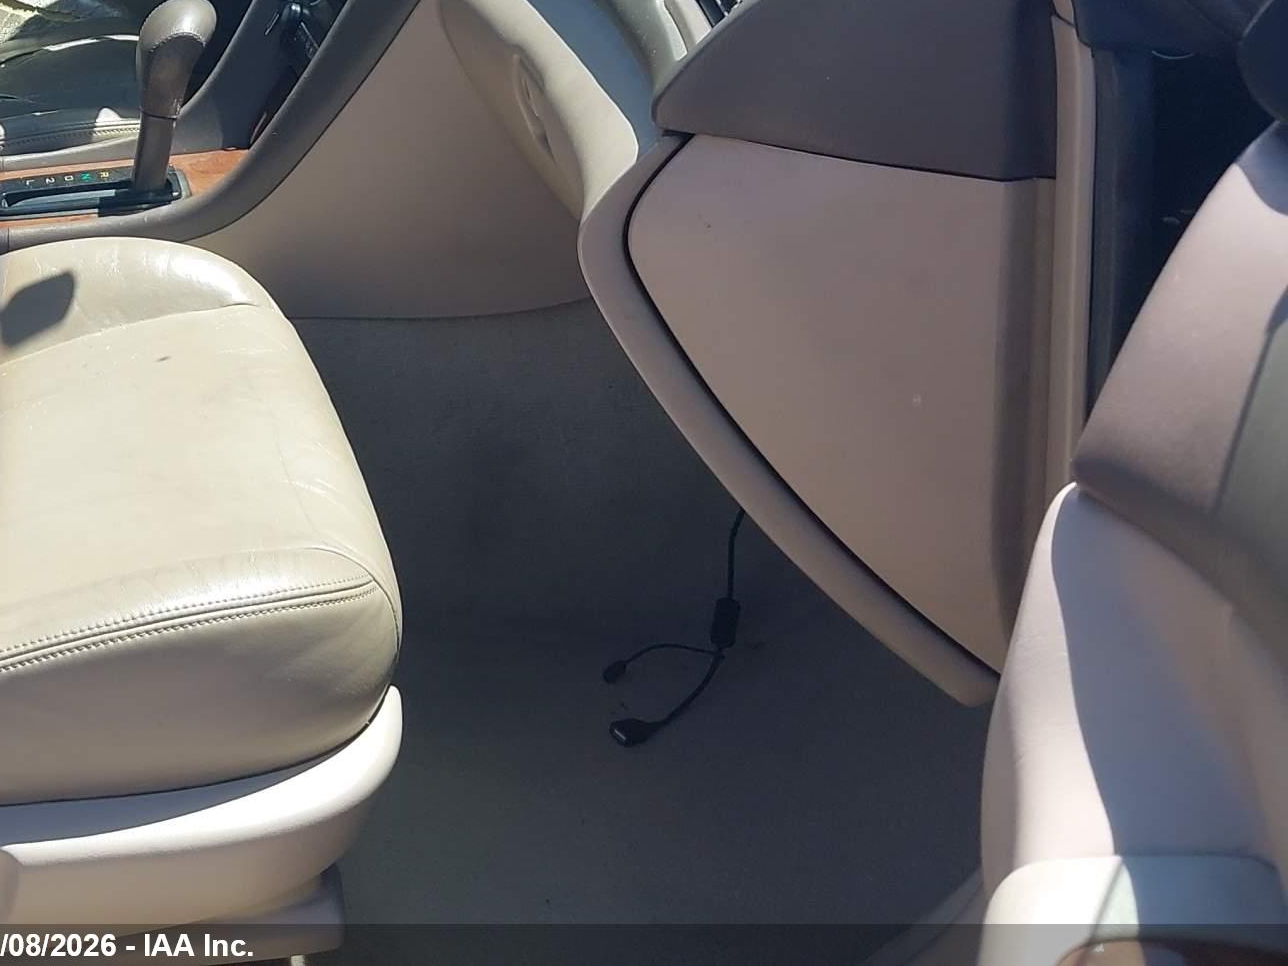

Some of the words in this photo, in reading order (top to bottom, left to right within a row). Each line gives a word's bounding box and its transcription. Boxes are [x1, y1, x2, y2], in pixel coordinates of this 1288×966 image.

[45, 177, 55, 185] 2
[80, 172, 91, 182] N
[100, 171, 109, 179] R
